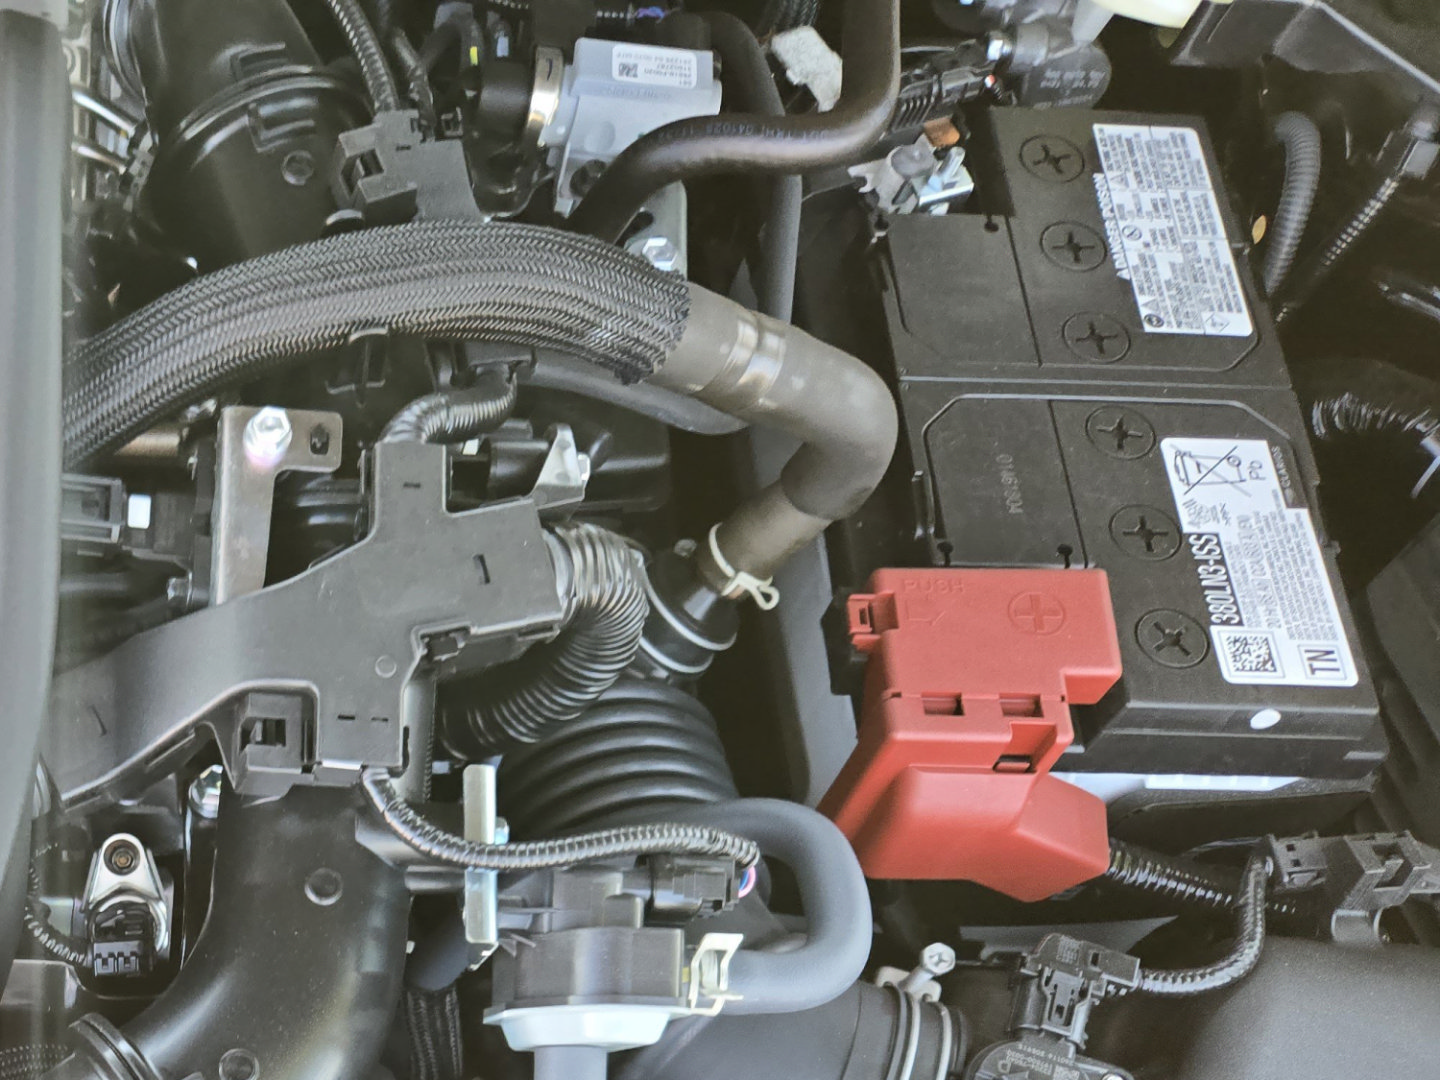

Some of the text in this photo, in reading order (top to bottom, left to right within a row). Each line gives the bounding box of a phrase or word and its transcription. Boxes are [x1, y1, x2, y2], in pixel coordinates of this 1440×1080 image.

[1247, 460, 1266, 481] Pb
[1188, 534, 1240, 623] 380LN3-ISS
[1303, 649, 1342, 676] TN
